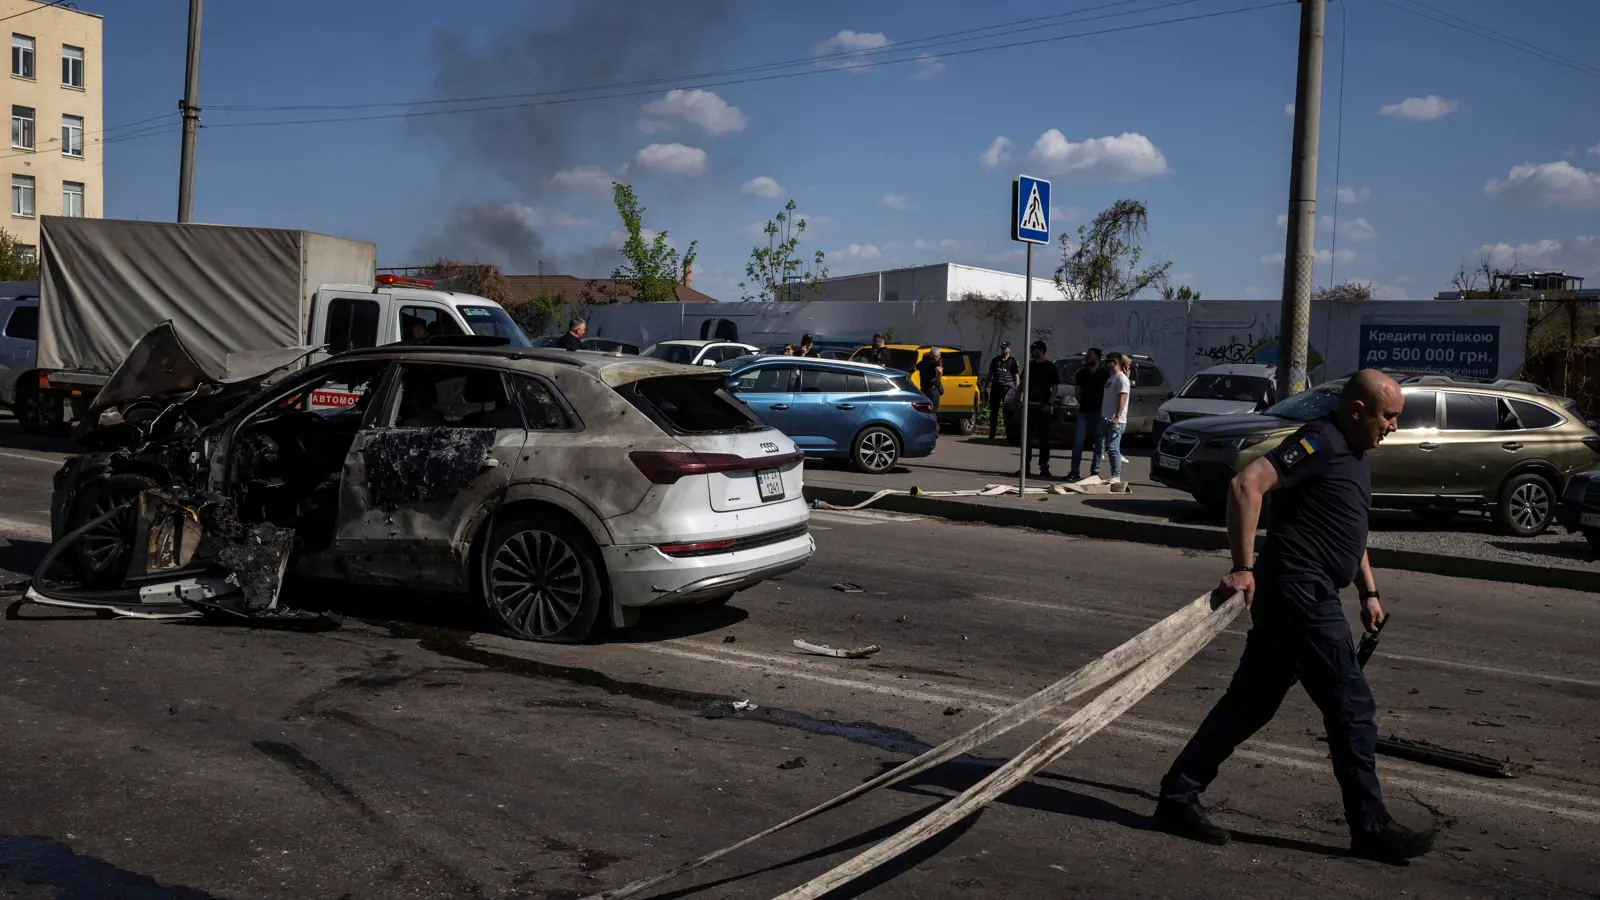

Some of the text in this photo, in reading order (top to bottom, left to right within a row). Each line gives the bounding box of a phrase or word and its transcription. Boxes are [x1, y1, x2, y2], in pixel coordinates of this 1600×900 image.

[1369, 329, 1493, 343] Кредити готівкою
[1366, 347, 1493, 364] до 500 000 грн.
[766, 481, 781, 494] 1241
